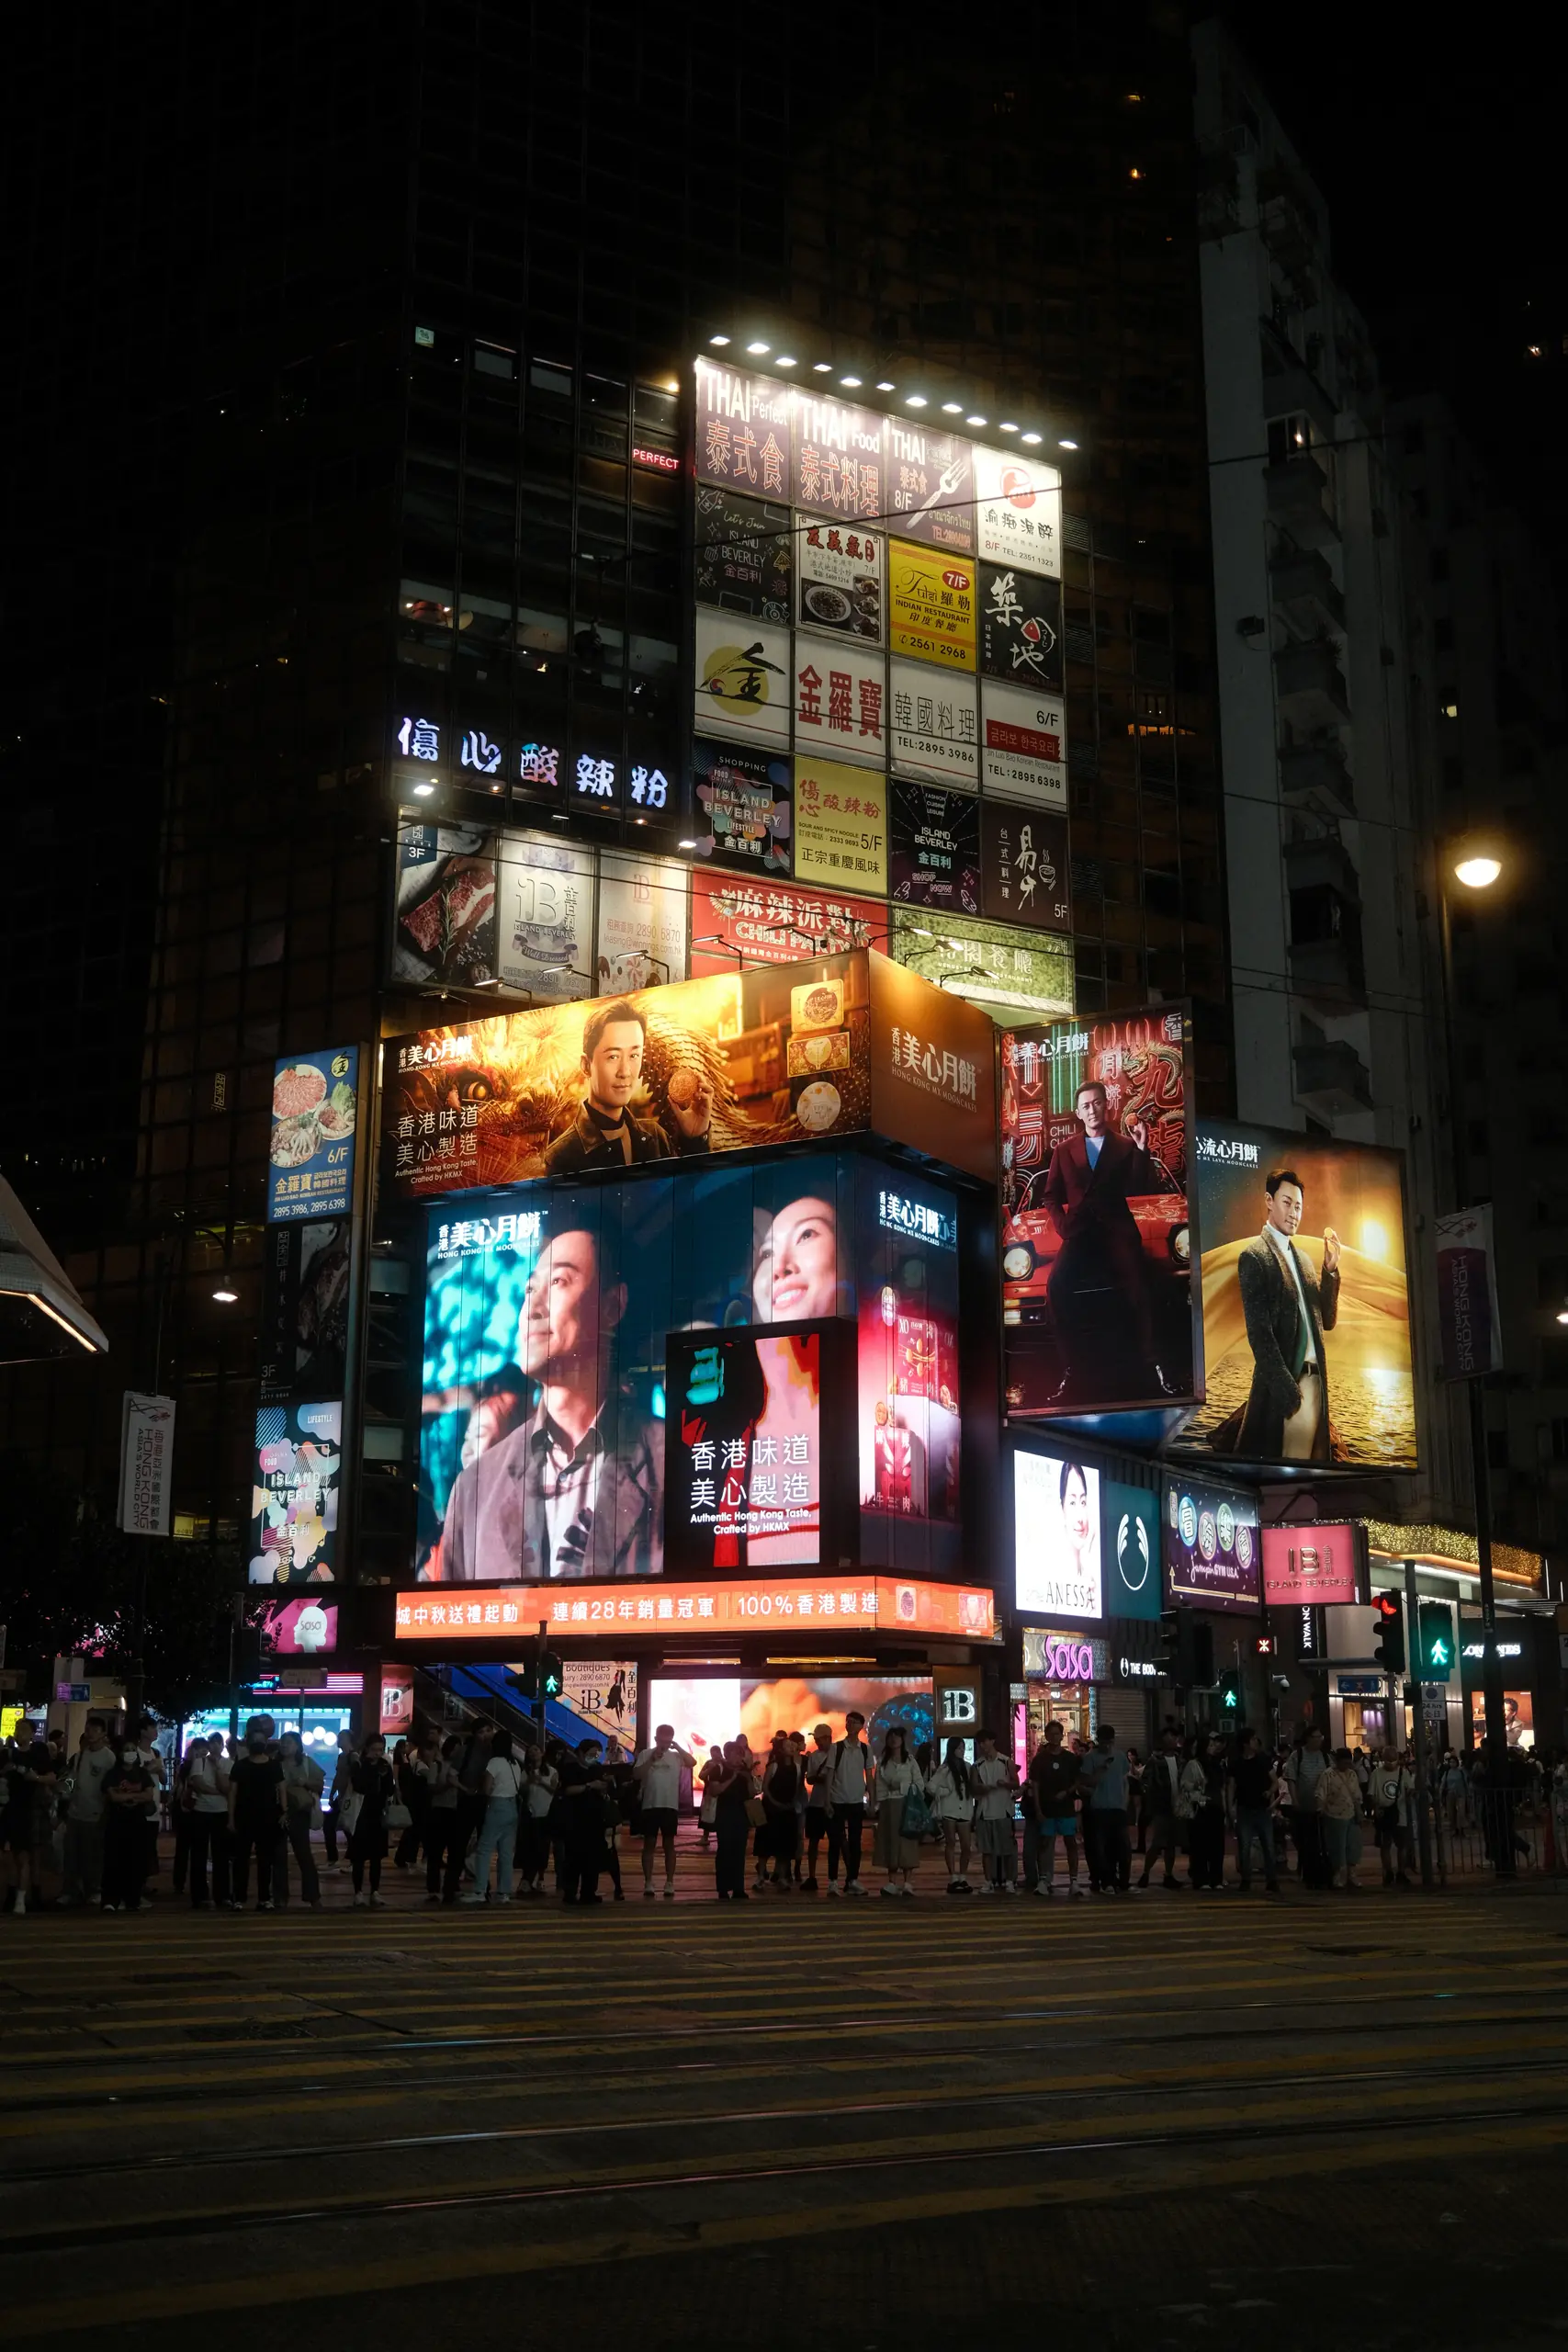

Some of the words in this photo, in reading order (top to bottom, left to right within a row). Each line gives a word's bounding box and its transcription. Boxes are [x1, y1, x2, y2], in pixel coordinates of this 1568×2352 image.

[705, 369, 750, 423] THAI
[752, 395, 787, 426] Perfect
[799, 396, 847, 452] THAI
[852, 429, 880, 454] Food
[706, 419, 785, 493] 泰式食
[891, 428, 926, 466] THAI
[632, 448, 681, 469] PERFECT
[800, 445, 879, 517] 泰式料理
[895, 490, 913, 511] 8/F
[723, 510, 743, 526] Let's
[728, 530, 759, 549] ISLAND
[721, 545, 766, 568] BEVERLEY
[985, 539, 1000, 552] 8/F
[1002, 548, 1019, 558] TEL:
[1019, 551, 1036, 562] 2351
[1037, 556, 1054, 568] 1323
[724, 563, 761, 583] 金百利
[864, 564, 875, 575] 7/F
[895, 566, 939, 603] Tulsi
[947, 572, 967, 589] 7/F
[940, 591, 970, 611] 羅勒
[896, 599, 921, 613] INDIAN
[924, 607, 970, 625] RESTAURANT
[908, 612, 958, 632] 印度餐廳
[910, 637, 935, 652] 2561
[940, 644, 966, 660] 2968
[798, 664, 882, 741] 金羅寶
[895, 691, 977, 745] 韓國料理
[1036, 710, 1059, 727] 6/F
[990, 727, 1017, 745] 금라보
[1021, 734, 1055, 756] 한국요리
[718, 756, 767, 773] SHOPPING
[948, 748, 974, 763] 3986
[714, 769, 728, 779] FOOD
[1037, 775, 1061, 789] 6398
[715, 788, 771, 808] ISLAND
[925, 792, 947, 801] FASHION
[926, 801, 945, 809] CUISINE
[705, 801, 781, 828] BEVERLEY
[926, 808, 944, 818] LEISURE
[727, 820, 755, 834] LIFESTYLE
[798, 821, 812, 830] SOUR
[839, 830, 859, 838] NOODLE
[920, 827, 951, 840] ISLAND
[724, 835, 762, 854] 金百利
[829, 835, 844, 844] 2333
[860, 833, 882, 851] 5/F
[914, 834, 958, 851] BEVERLEY
[408, 846, 426, 859] 3F
[801, 847, 881, 874] 正宗重慶風味
[919, 851, 952, 869] 金百利
[911, 873, 936, 882] SHOP
[930, 884, 953, 893] NOW
[736, 888, 854, 935] 麻辣派對
[1054, 903, 1067, 918] 5F
[514, 922, 541, 934] ISLAND
[544, 927, 577, 942] BEVERLEY
[637, 923, 657, 939] 2890
[661, 927, 680, 943] 6870
[735, 922, 786, 945] CHILI
[789, 933, 852, 954] PARTY
[399, 1047, 407, 1068] 香港
[407, 1035, 473, 1066] 美心月餅
[1018, 1033, 1089, 1060] 美心月餅
[398, 1065, 415, 1073] HONG
[415, 1063, 431, 1071] KONG
[892, 1027, 901, 1068] 香港
[903, 1031, 976, 1101] 美心月餅
[892, 1068, 912, 1087] HONG
[912, 1075, 931, 1092] KONG
[932, 1083, 942, 1096] MX
[942, 1089, 977, 1114] MOONCAKES
[398, 1103, 479, 1138] 香港味道
[1050, 1124, 1077, 1137] CHILI
[327, 1148, 349, 1163] 6/F
[397, 1132, 478, 1166] 美心製造
[395, 1166, 423, 1177] Authentic
[425, 1164, 442, 1174] Hong
[443, 1161, 459, 1171] Kong
[460, 1159, 479, 1168] Taste,
[1226, 1159, 1258, 1169] MOONCAKES
[276, 1173, 312, 1193] 金羅寶
[411, 1175, 434, 1184] Crafted
[444, 1170, 463, 1179] HKMX
[273, 1205, 290, 1217] 2895
[310, 1200, 328, 1212] 2895
[328, 1198, 345, 1210] 6398
[879, 1192, 886, 1217] 香港
[887, 1193, 940, 1238] 美心月餅
[438, 1224, 448, 1251] 香港
[450, 1212, 541, 1250] 美心月餅
[879, 1218, 893, 1228] HONG
[893, 1223, 906, 1232] KONG
[914, 1232, 940, 1246] MOONCAKES
[437, 1250, 459, 1260] HONG
[460, 1247, 482, 1257] KONG
[1458, 1255, 1470, 1311] HONG
[899, 1318, 909, 1334] XO
[1460, 1315, 1474, 1371] KONG
[261, 1364, 277, 1378] 3F
[308, 1414, 333, 1424] LIFESTYLE
[136, 1428, 144, 1461] ASIA'S
[141, 1428, 153, 1477] HONG
[691, 1434, 809, 1471] 香港味道
[265, 1457, 277, 1466] FOOD
[133, 1462, 141, 1500] WORLD
[271, 1472, 321, 1487] ISLAND
[261, 1488, 331, 1504] BEVERLEY
[690, 1472, 809, 1509] 美心製造
[139, 1480, 151, 1530] KONG
[131, 1502, 140, 1529] CITY
[690, 1512, 732, 1523] Authentic
[734, 1510, 758, 1522] Hong
[760, 1510, 784, 1521] Kong
[785, 1509, 812, 1519] Taste,
[277, 1523, 310, 1537] 金百利
[714, 1523, 745, 1534] Crafted
[747, 1523, 761, 1534] by
[762, 1521, 790, 1532] HKMX
[1267, 1579, 1302, 1589] ISLAND
[1305, 1577, 1355, 1588] BEVERLEY
[738, 1591, 879, 1616] 100%香港製造
[1045, 1580, 1095, 1610] ANESSA
[552, 1597, 714, 1623] 連續28年銷量冠軍
[1302, 1623, 1312, 1649] WALK
[1130, 1662, 1141, 1675] THE
[581, 1689, 602, 1710] iB
[626, 1670, 637, 1713] 金百利
[943, 1689, 976, 1722] iB
[1424, 1710, 1441, 1718] 全日
